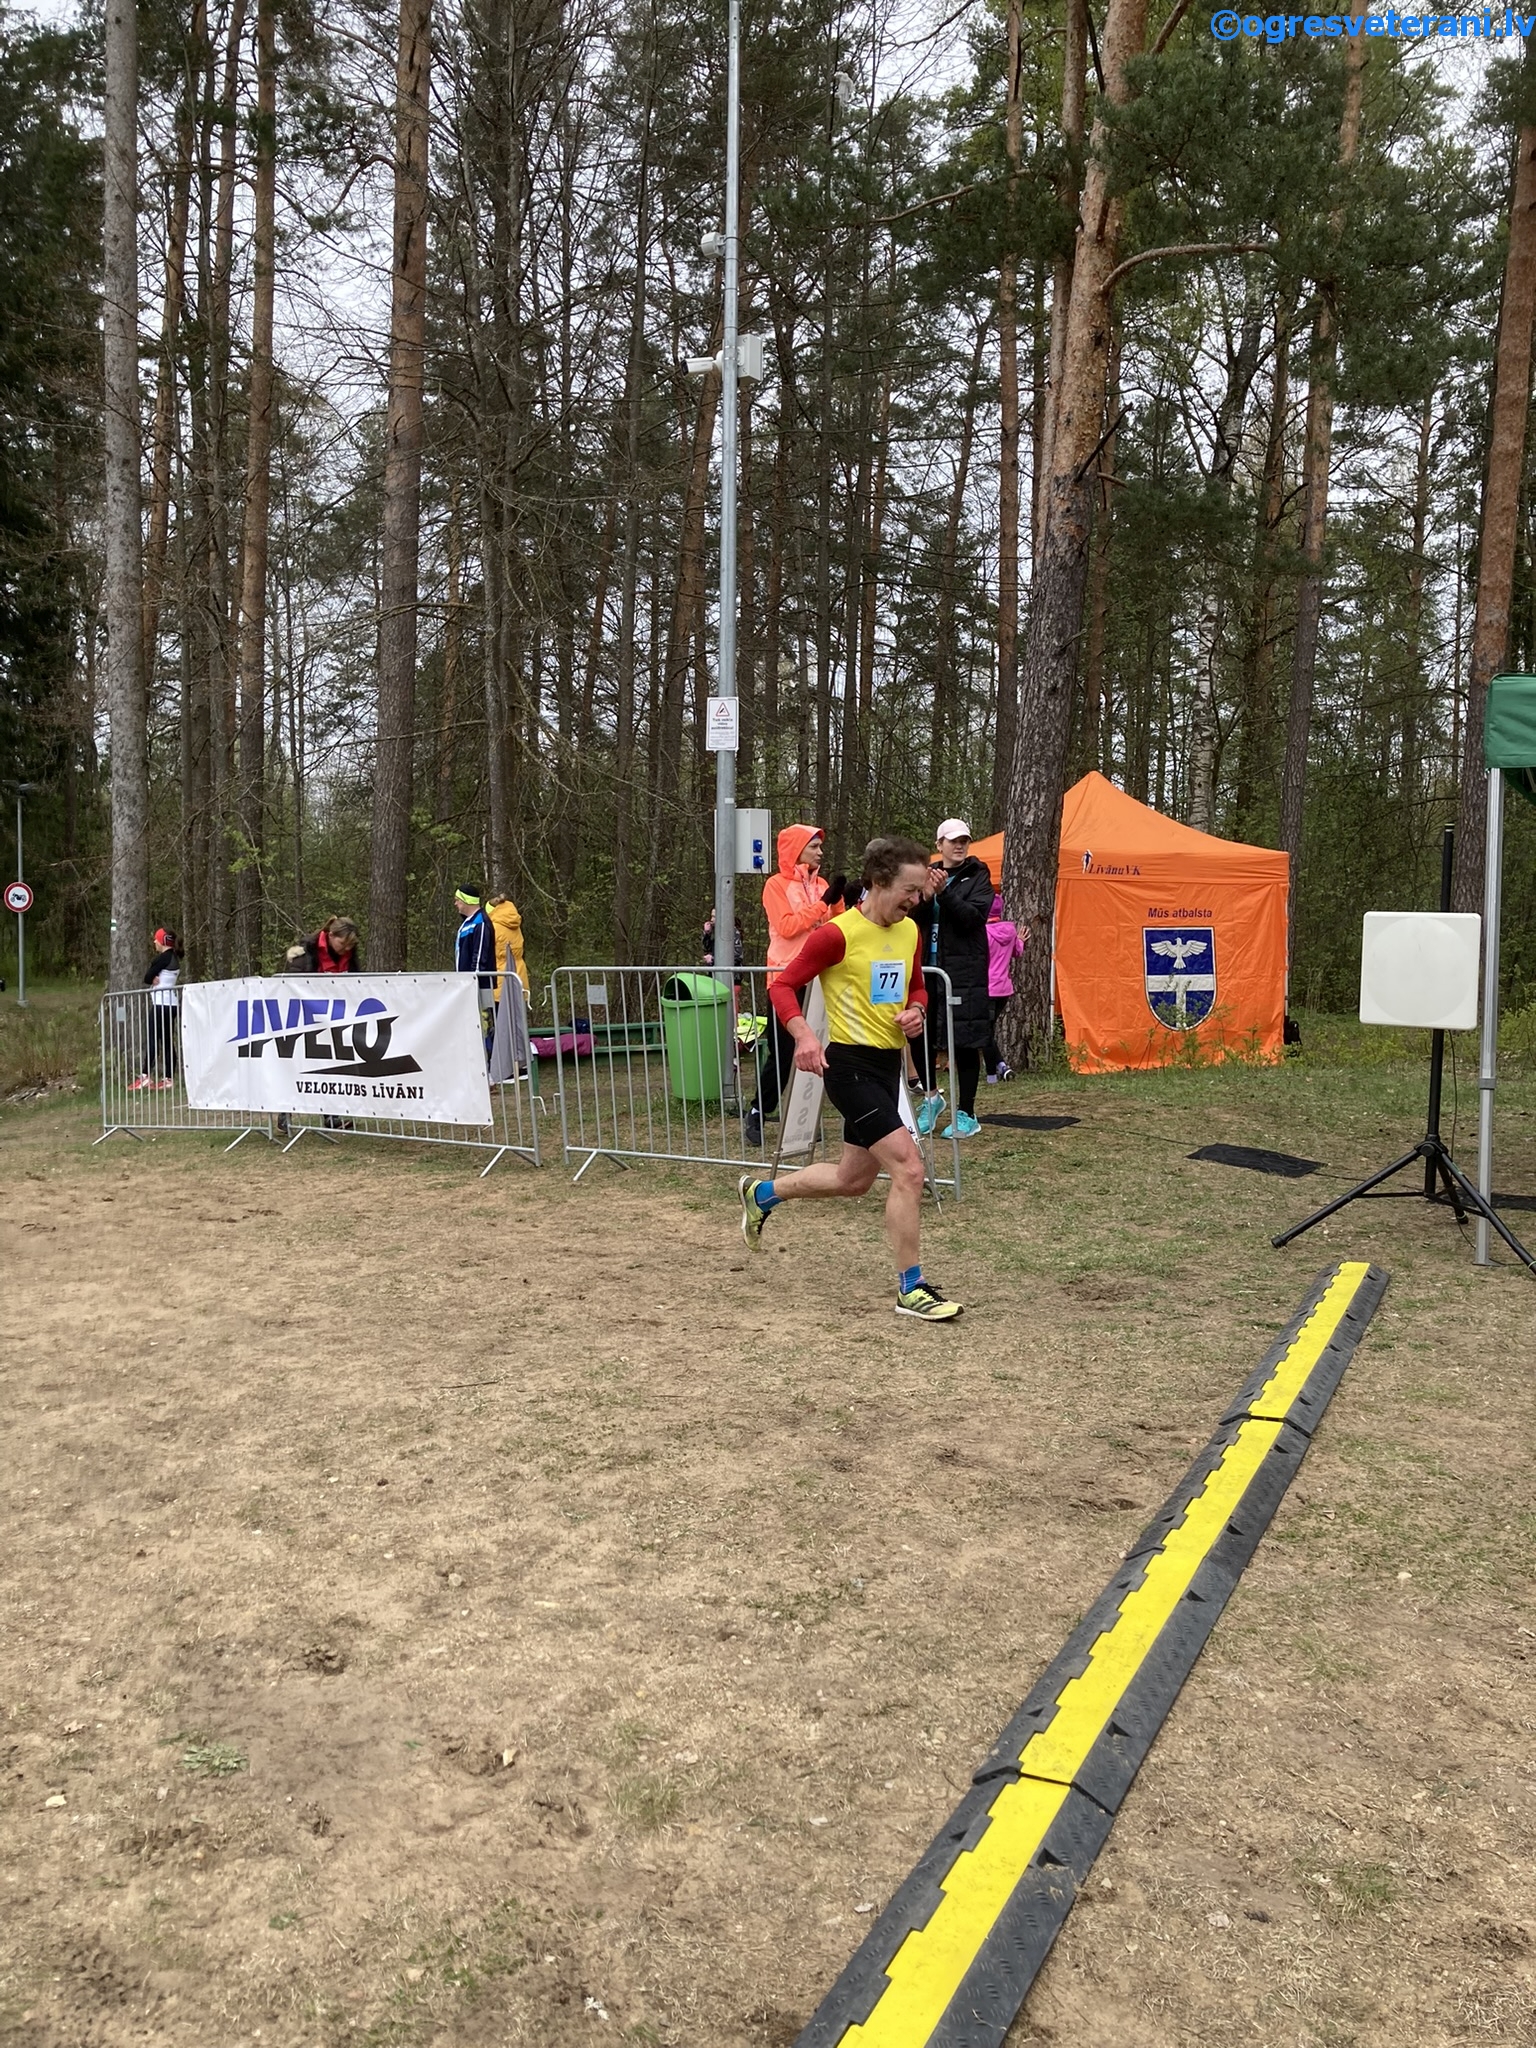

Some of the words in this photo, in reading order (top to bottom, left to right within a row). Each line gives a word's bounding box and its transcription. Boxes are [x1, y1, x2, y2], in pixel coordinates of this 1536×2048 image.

[1148, 907, 1169, 918] Mūs
[1172, 907, 1213, 918] atbalsta
[880, 972, 899, 989] 77
[296, 1081, 367, 1097] VELOKLUBS
[372, 1083, 424, 1099] LĪVĀNI
